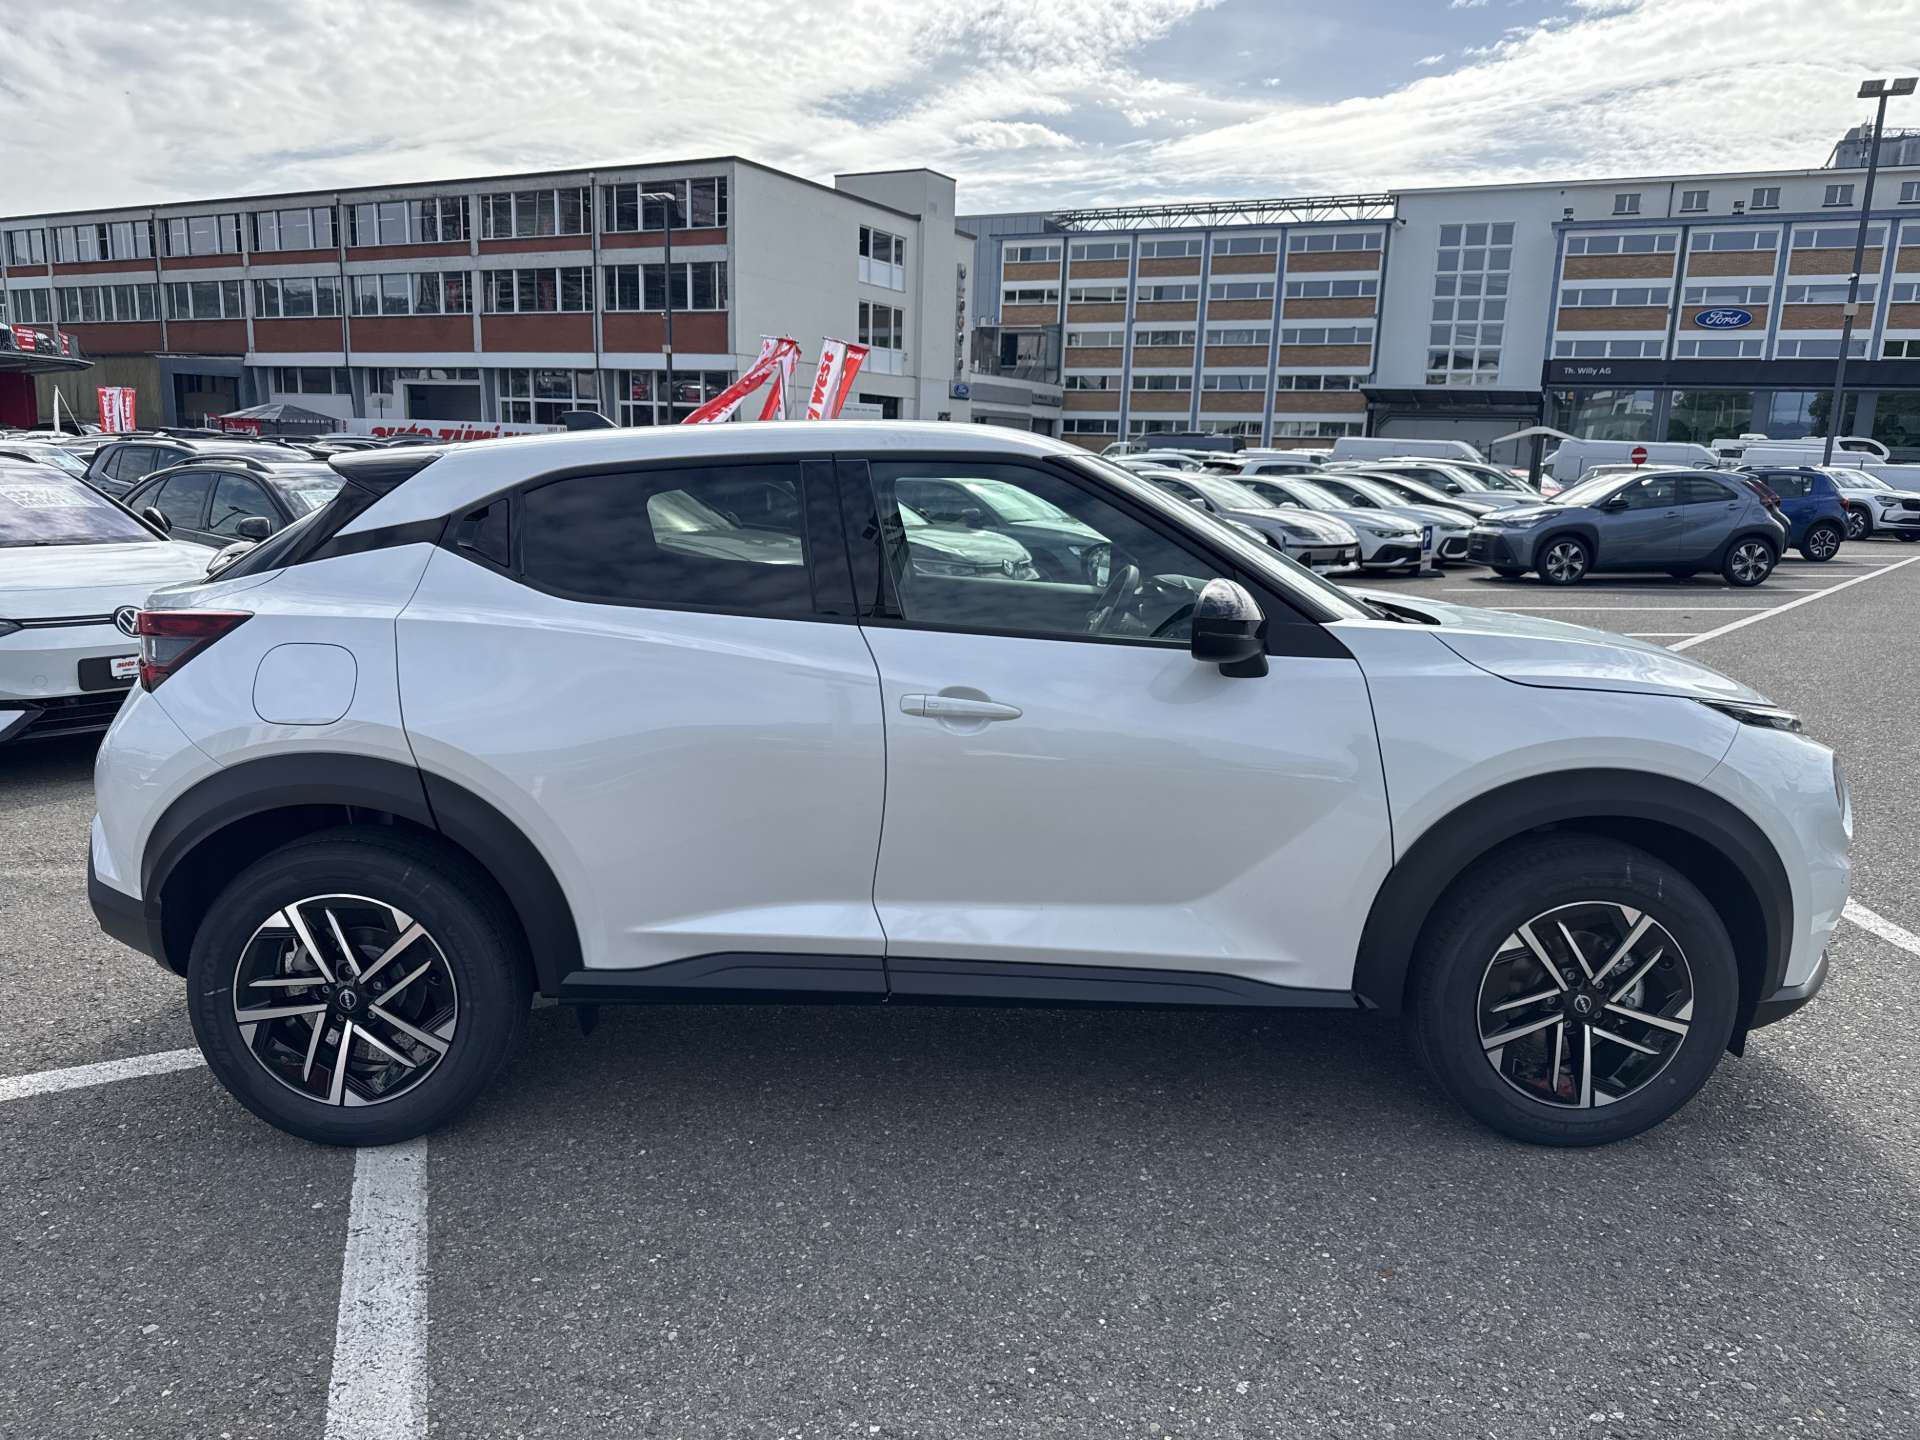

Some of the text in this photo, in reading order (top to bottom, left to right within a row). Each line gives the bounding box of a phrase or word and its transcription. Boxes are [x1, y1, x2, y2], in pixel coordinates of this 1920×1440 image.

[1706, 311, 1742, 325] Ford
[812, 351, 834, 405] west
[1577, 367, 1597, 376] Willy
[1599, 367, 1612, 375] AG
[1424, 530, 1430, 548] P
